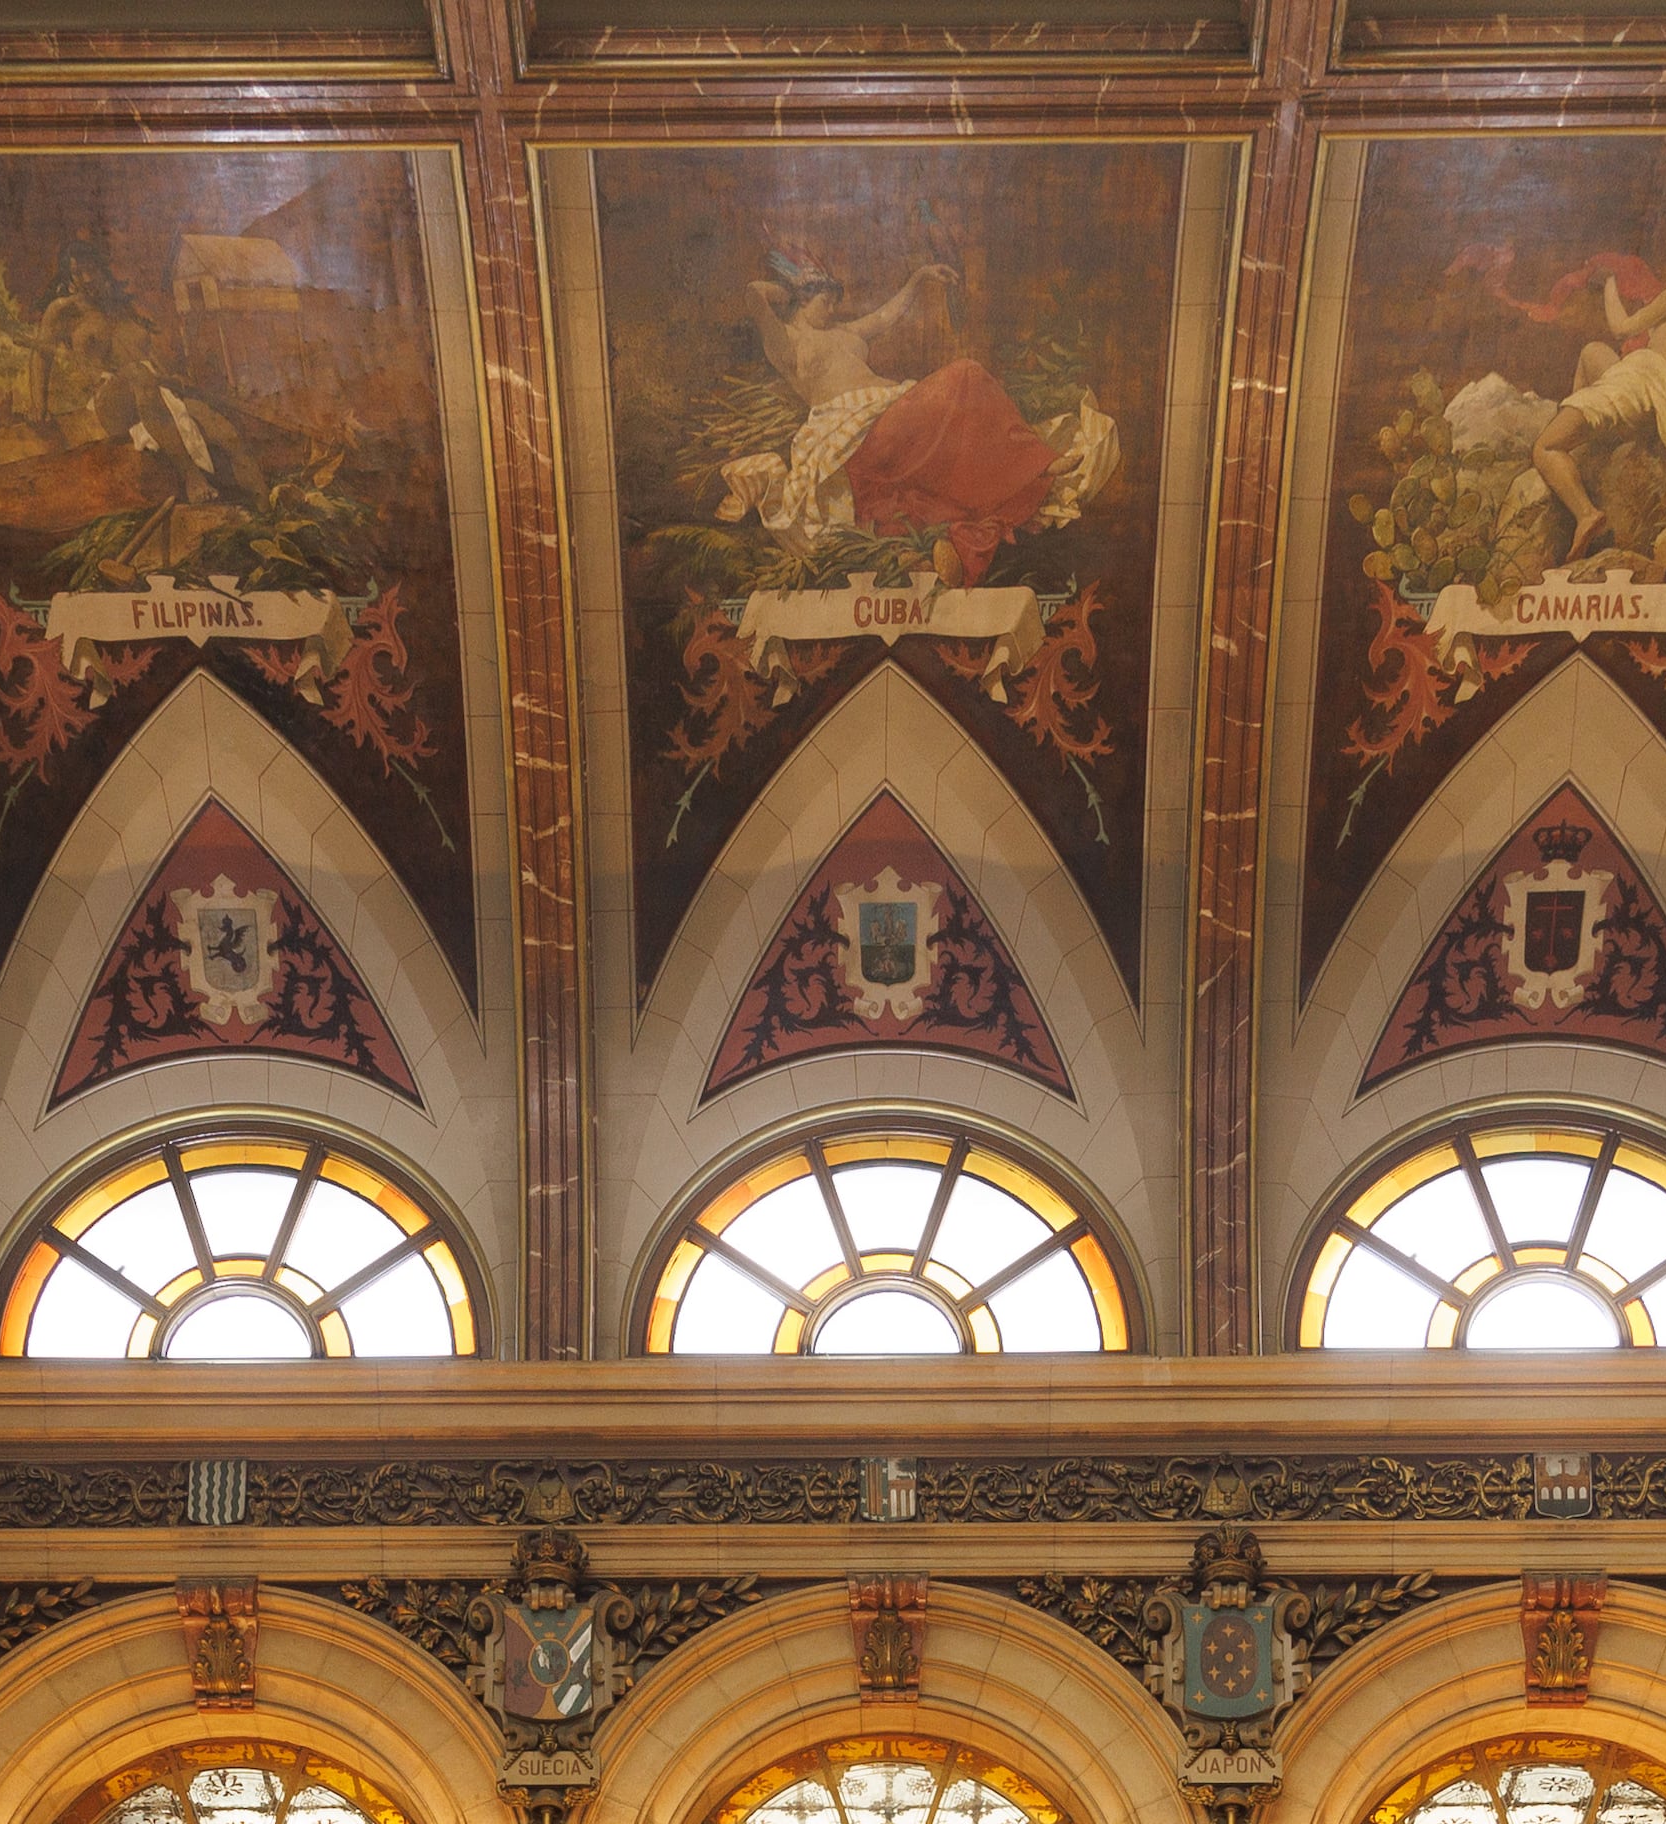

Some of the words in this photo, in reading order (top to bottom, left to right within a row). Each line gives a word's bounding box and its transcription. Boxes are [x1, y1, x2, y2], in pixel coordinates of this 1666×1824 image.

[133, 600, 262, 629] FILIPINAS.
[1517, 593, 1650, 624] CANARIAS.
[518, 1759, 581, 1776] SUECIA
[1197, 1756, 1262, 1774] JAPON
